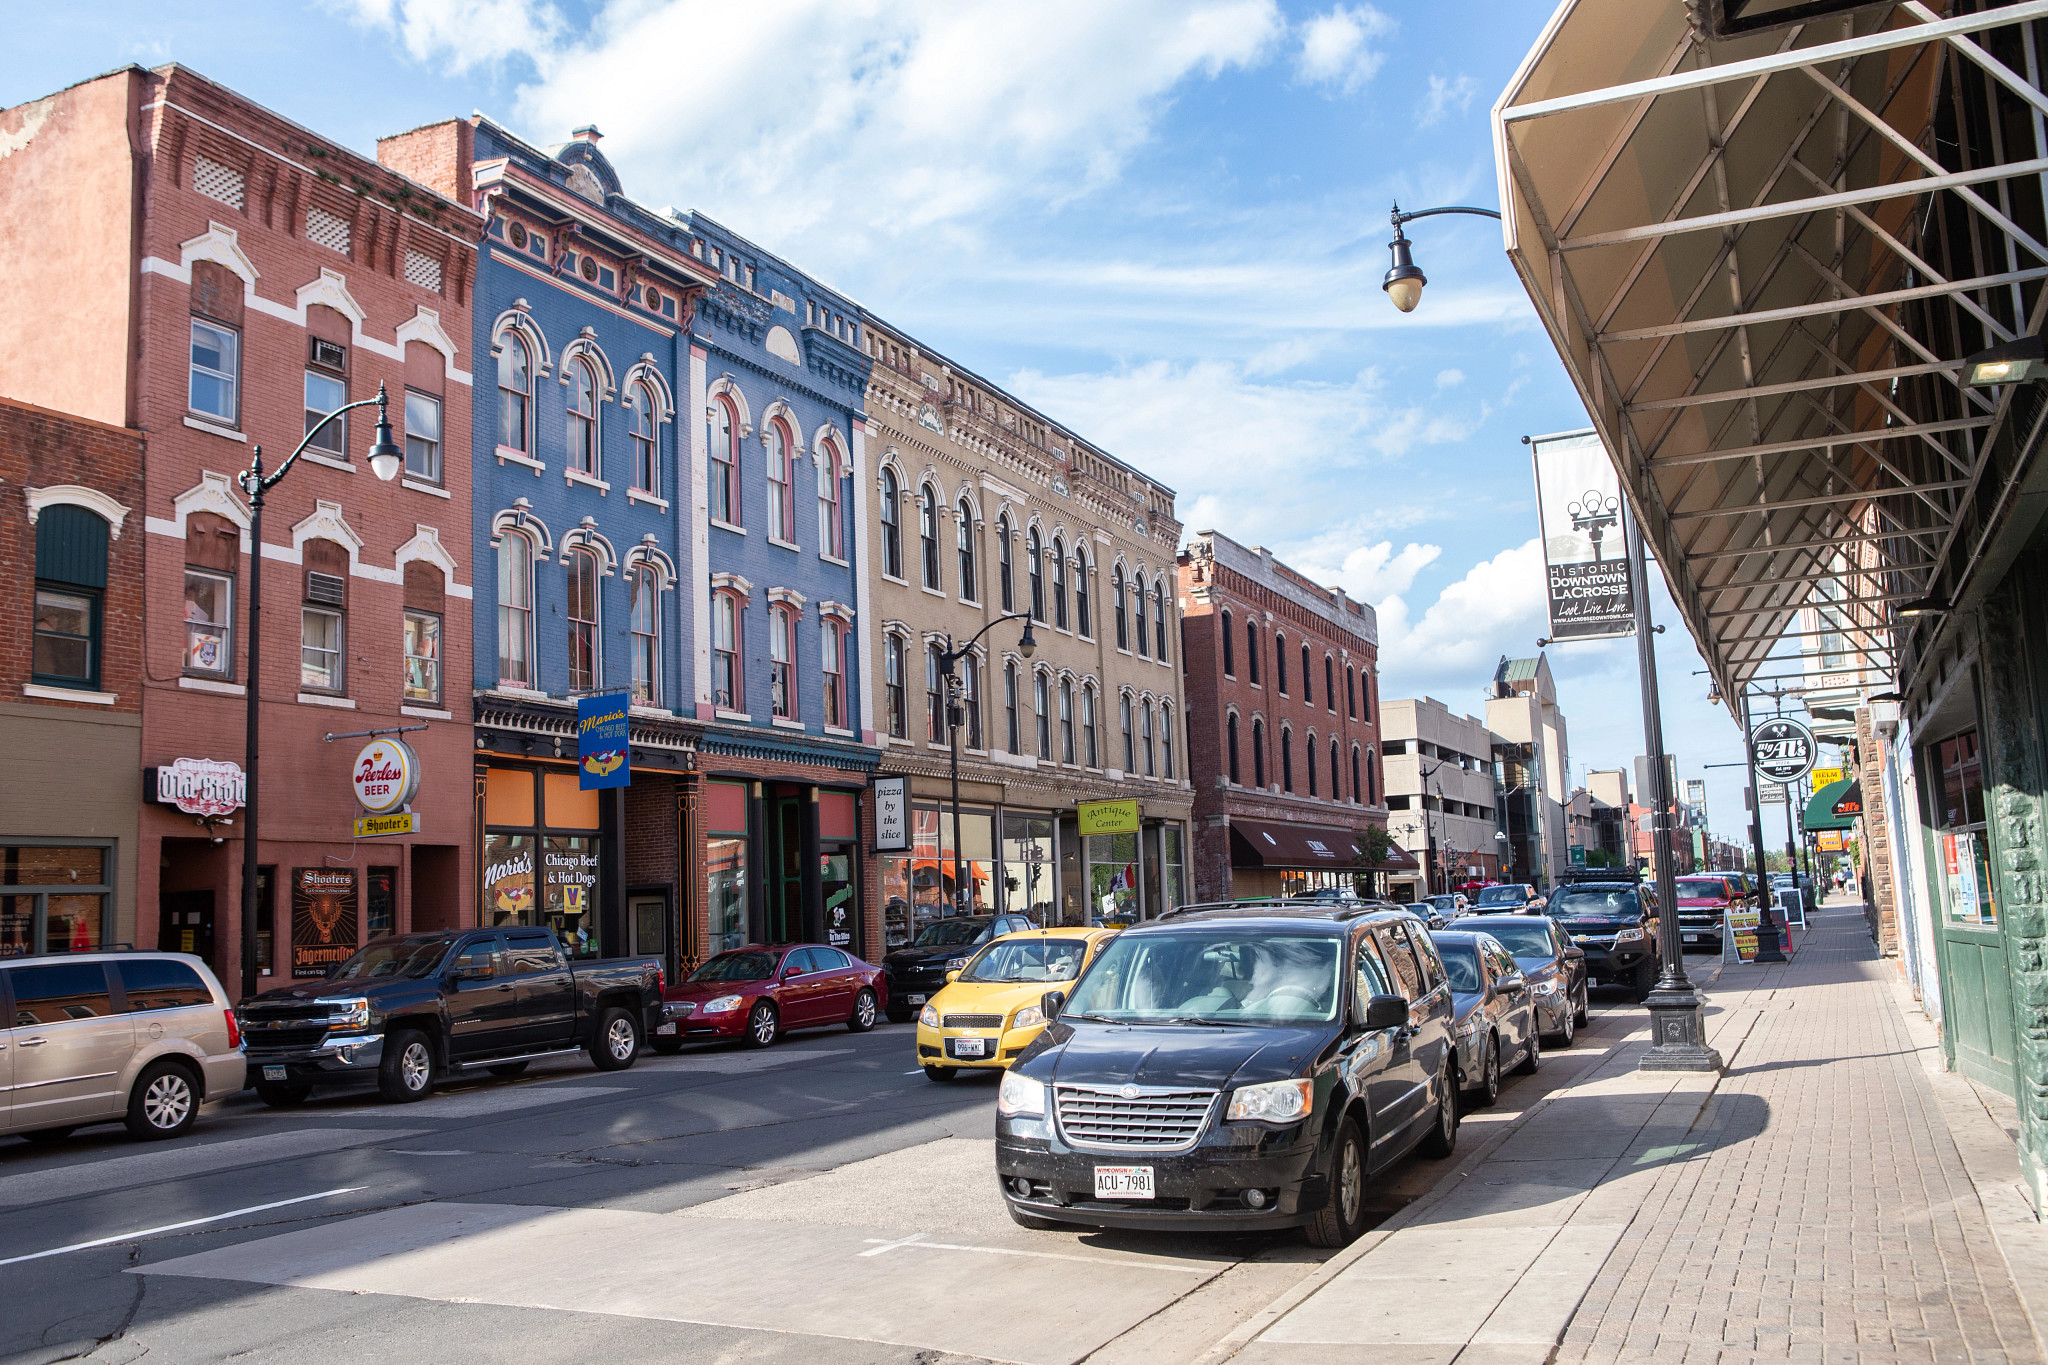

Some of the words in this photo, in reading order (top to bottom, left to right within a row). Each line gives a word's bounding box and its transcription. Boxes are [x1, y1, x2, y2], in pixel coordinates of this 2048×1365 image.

[1550, 562, 1625, 577] HISTORIC
[1550, 572, 1627, 589] DOWNTOWN
[1558, 600, 1581, 617] Look.
[1583, 600, 1604, 615] Live.
[1606, 598, 1628, 613] Love.
[579, 709, 626, 734] Mario's
[595, 724, 615, 733] CHICAGO
[615, 722, 627, 731] BEEF
[1757, 739, 1807, 760] Al's
[355, 758, 402, 784] Peerless
[1815, 771, 1838, 779] HELM
[364, 784, 390, 796] BEER
[876, 786, 903, 799] pizza
[884, 800, 896, 813] by
[1087, 804, 1131, 820] Antique
[366, 817, 409, 834] Shooter's
[883, 814, 898, 825] the
[1095, 819, 1123, 829] Center
[880, 829, 901, 840] slice
[545, 853, 578, 870] Chicago
[580, 854, 599, 867] Beef
[301, 871, 351, 887] Shooters
[547, 871, 556, 884] &
[558, 871, 575, 884] Hot
[576, 871, 596, 888] Dogs
[1098, 1175, 1152, 1191] ACU-7981
